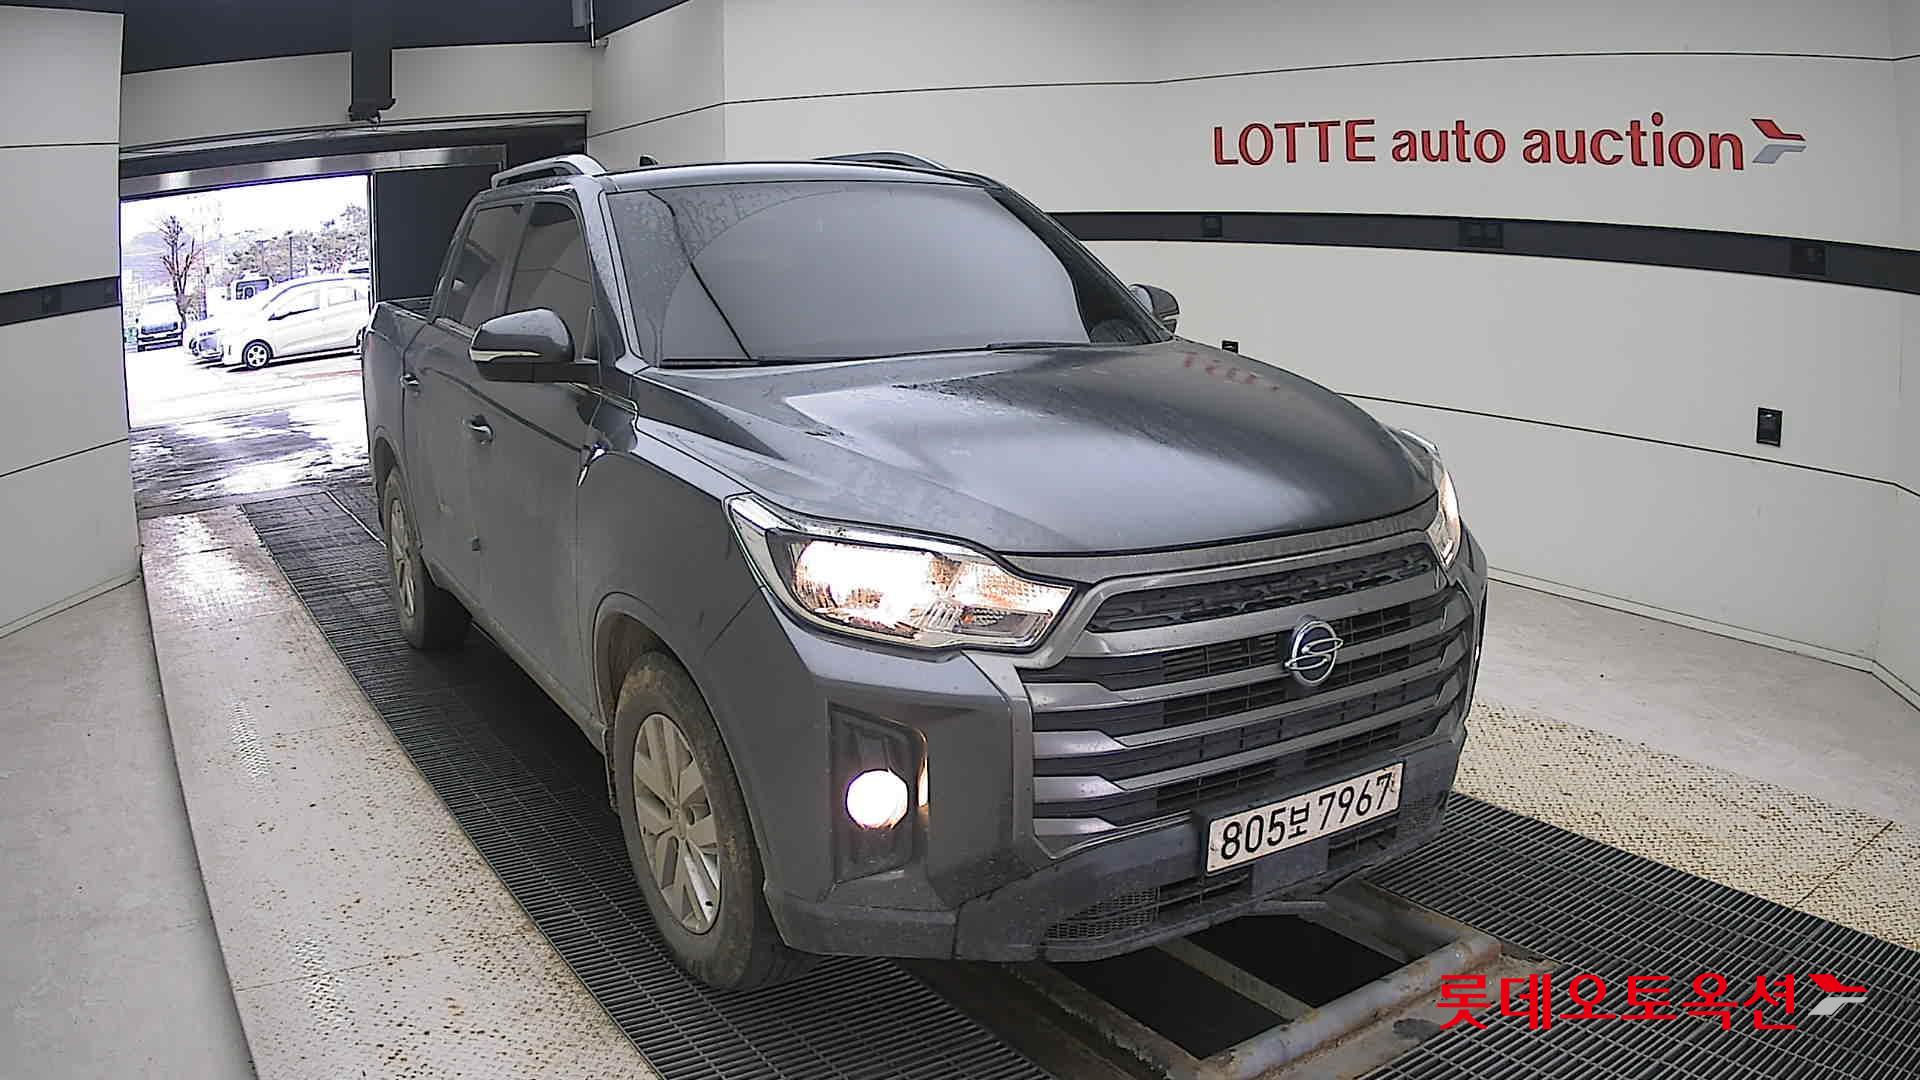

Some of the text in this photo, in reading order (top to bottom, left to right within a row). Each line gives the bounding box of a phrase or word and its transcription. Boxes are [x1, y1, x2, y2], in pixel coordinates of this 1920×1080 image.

[1213, 111, 1745, 171] LOTTE auto auction
